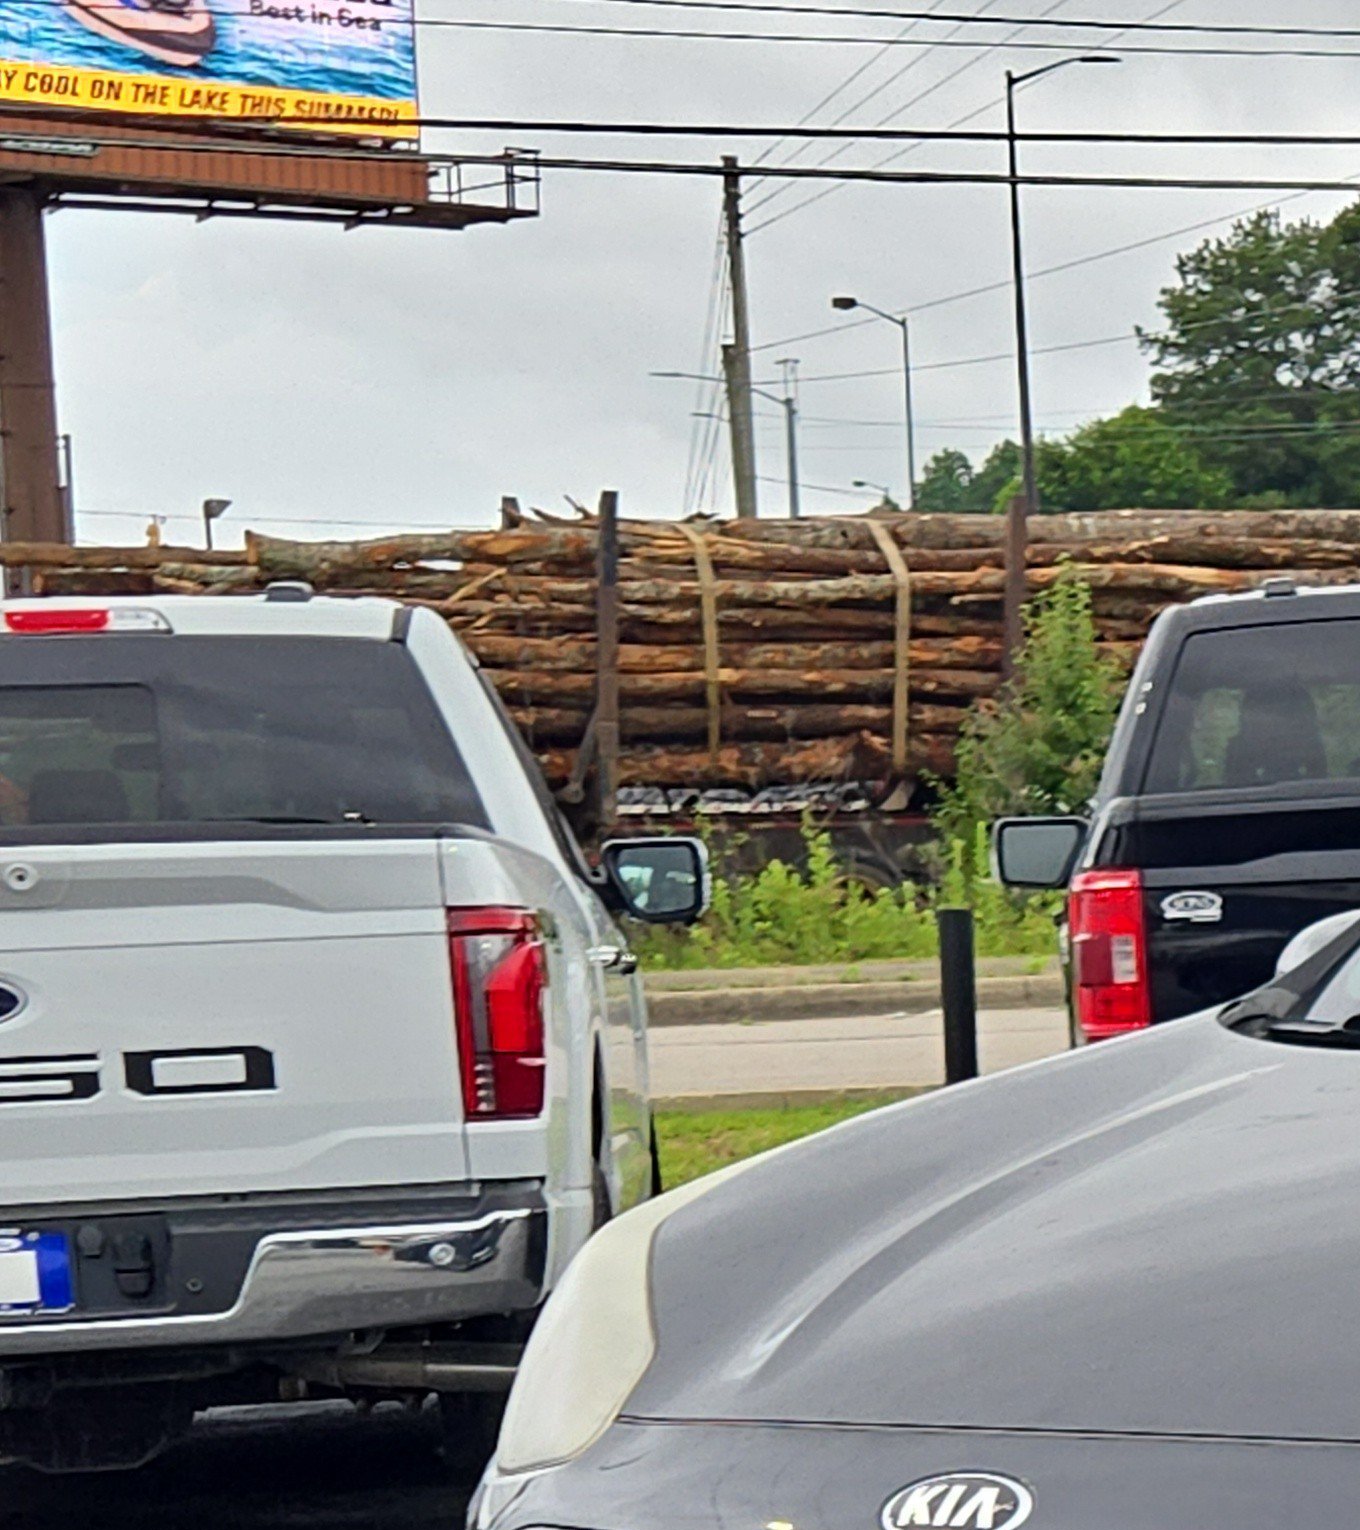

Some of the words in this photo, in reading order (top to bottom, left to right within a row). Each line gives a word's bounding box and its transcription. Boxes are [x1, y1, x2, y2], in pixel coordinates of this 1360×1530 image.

[250, 0, 304, 24] Best
[311, 4, 332, 27] in
[24, 72, 79, 97] COOL
[90, 79, 122, 101] ON
[131, 82, 170, 106] THE
[179, 87, 229, 112] LAKE
[239, 93, 286, 116] THIS
[896, 1484, 999, 1529] KIA
